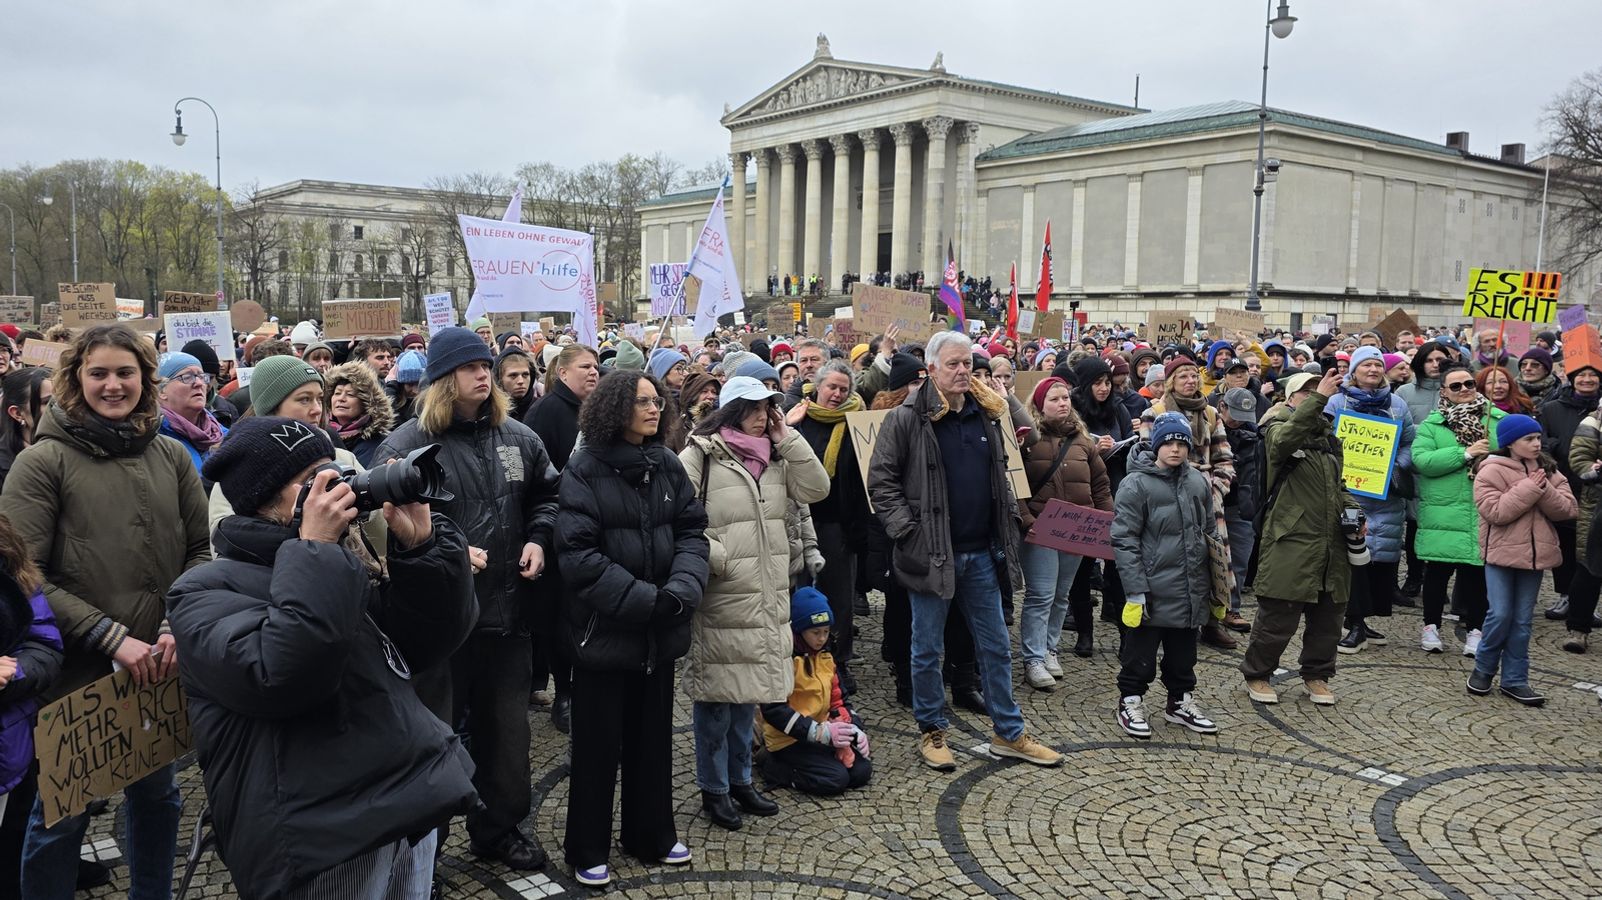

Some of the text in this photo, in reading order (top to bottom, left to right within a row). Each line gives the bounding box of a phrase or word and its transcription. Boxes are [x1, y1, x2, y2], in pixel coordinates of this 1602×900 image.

[466, 227, 480, 237] EIN
[484, 228, 515, 240] LEBEN
[517, 231, 546, 243] OHNE
[72, 284, 100, 293] SCHAM
[77, 294, 96, 302] MUSS
[165, 293, 192, 304] KEIN
[861, 286, 895, 304] ANGRY
[63, 303, 77, 311] DIE
[78, 302, 107, 311] SEITE
[340, 301, 390, 311] misstrauen
[1468, 291, 1558, 323] REICHT
[78, 311, 117, 321] WECHSELN
[326, 311, 343, 320] weil
[173, 319, 185, 328] du
[186, 318, 200, 328] bist
[326, 321, 341, 329] wir
[1158, 323, 1177, 333] NUR
[1178, 319, 1192, 337] JA
[176, 326, 217, 339] STIMME
[838, 333, 862, 344] JUST
[48, 684, 101, 736] ALS
[57, 706, 122, 768] MEHR
[49, 726, 133, 791] WOLLTEN
[55, 775, 95, 818] WIR
[111, 738, 162, 788] KEINE
